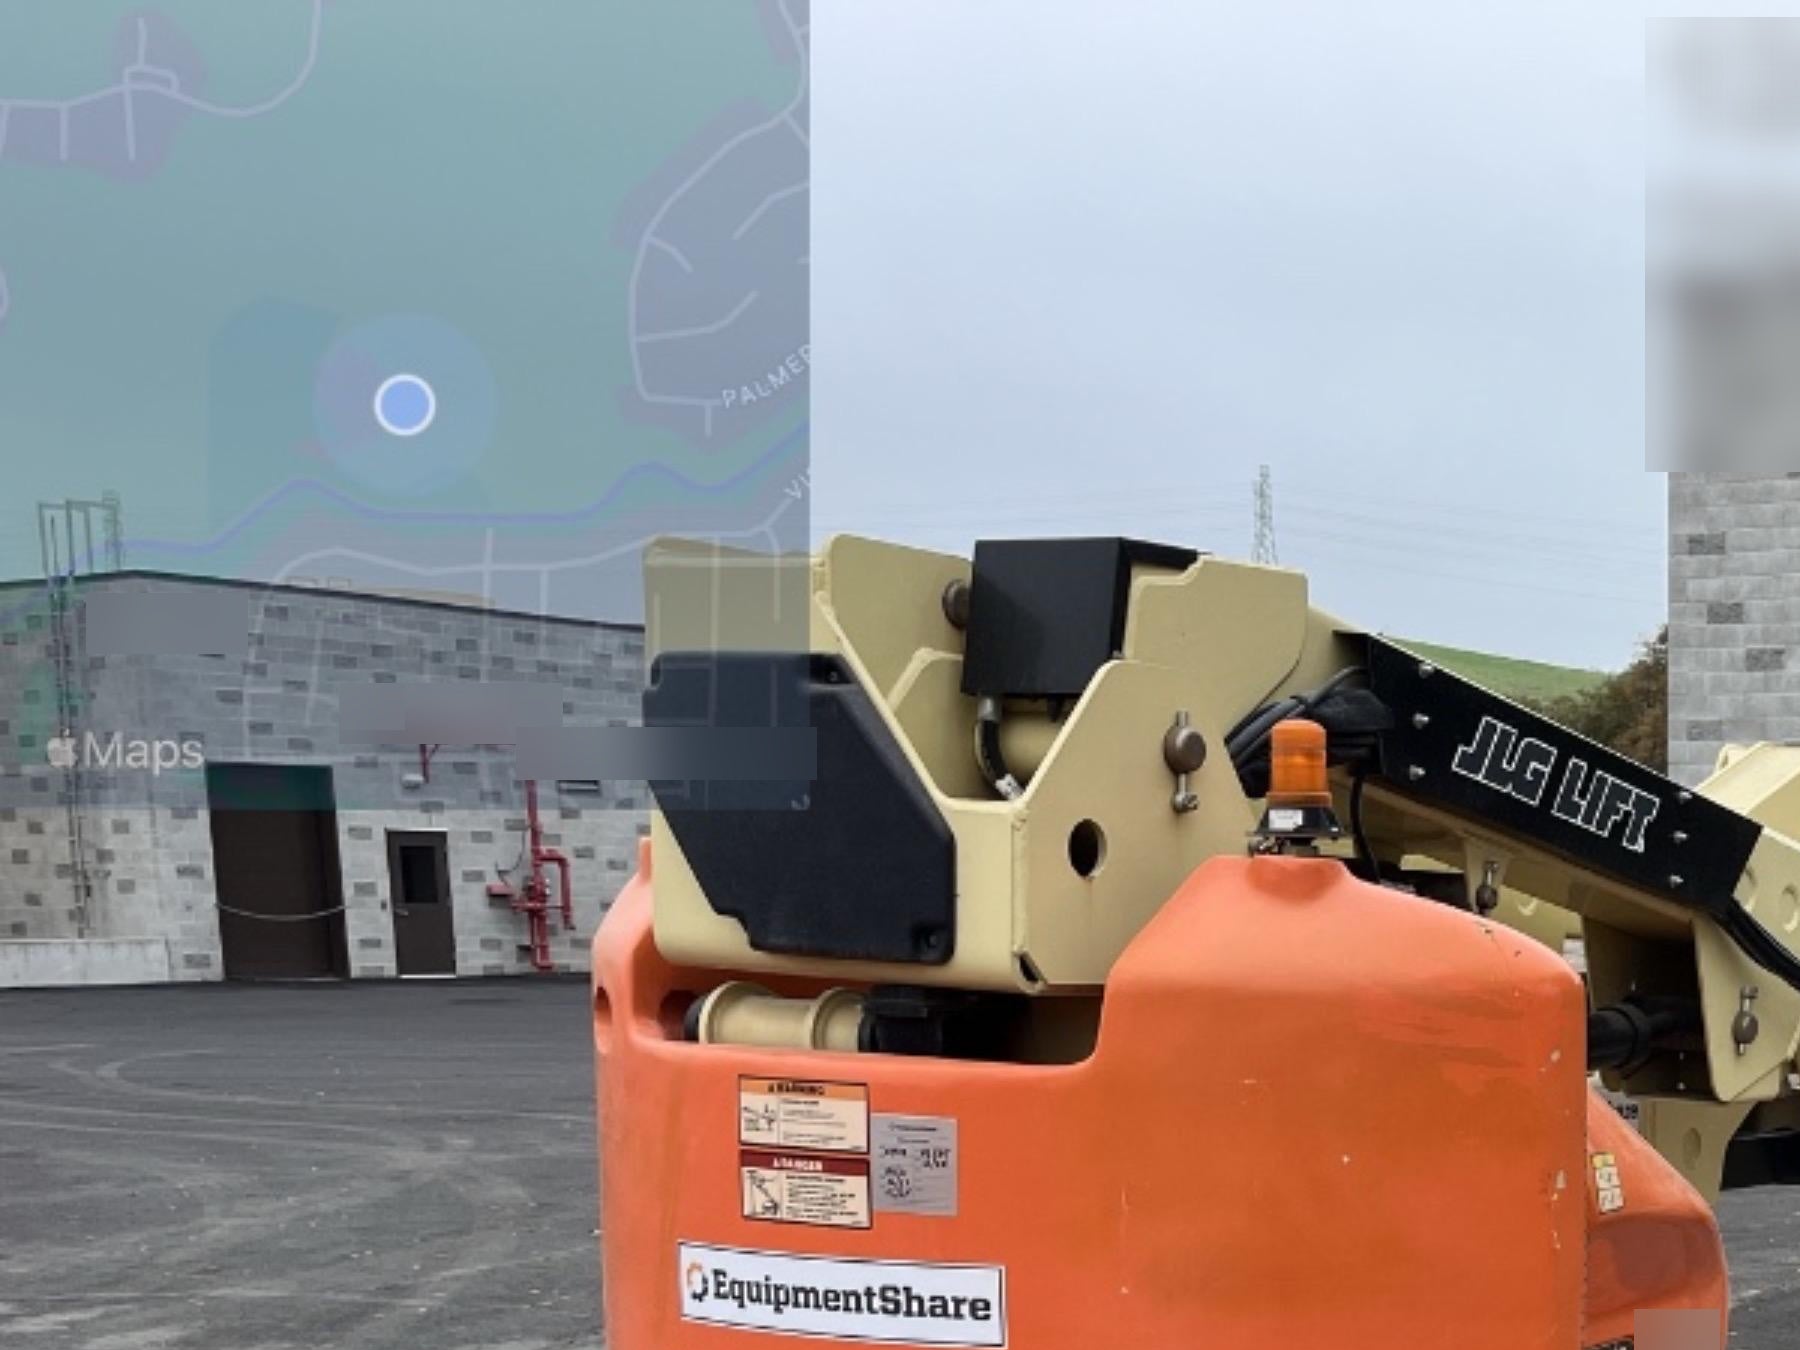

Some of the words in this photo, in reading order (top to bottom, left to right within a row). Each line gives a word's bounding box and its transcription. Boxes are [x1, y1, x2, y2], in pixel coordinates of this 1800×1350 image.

[1452, 715, 1558, 808] JLG
[1551, 755, 1660, 854] LIFT
[711, 1268, 993, 1322] EquipmentShare
